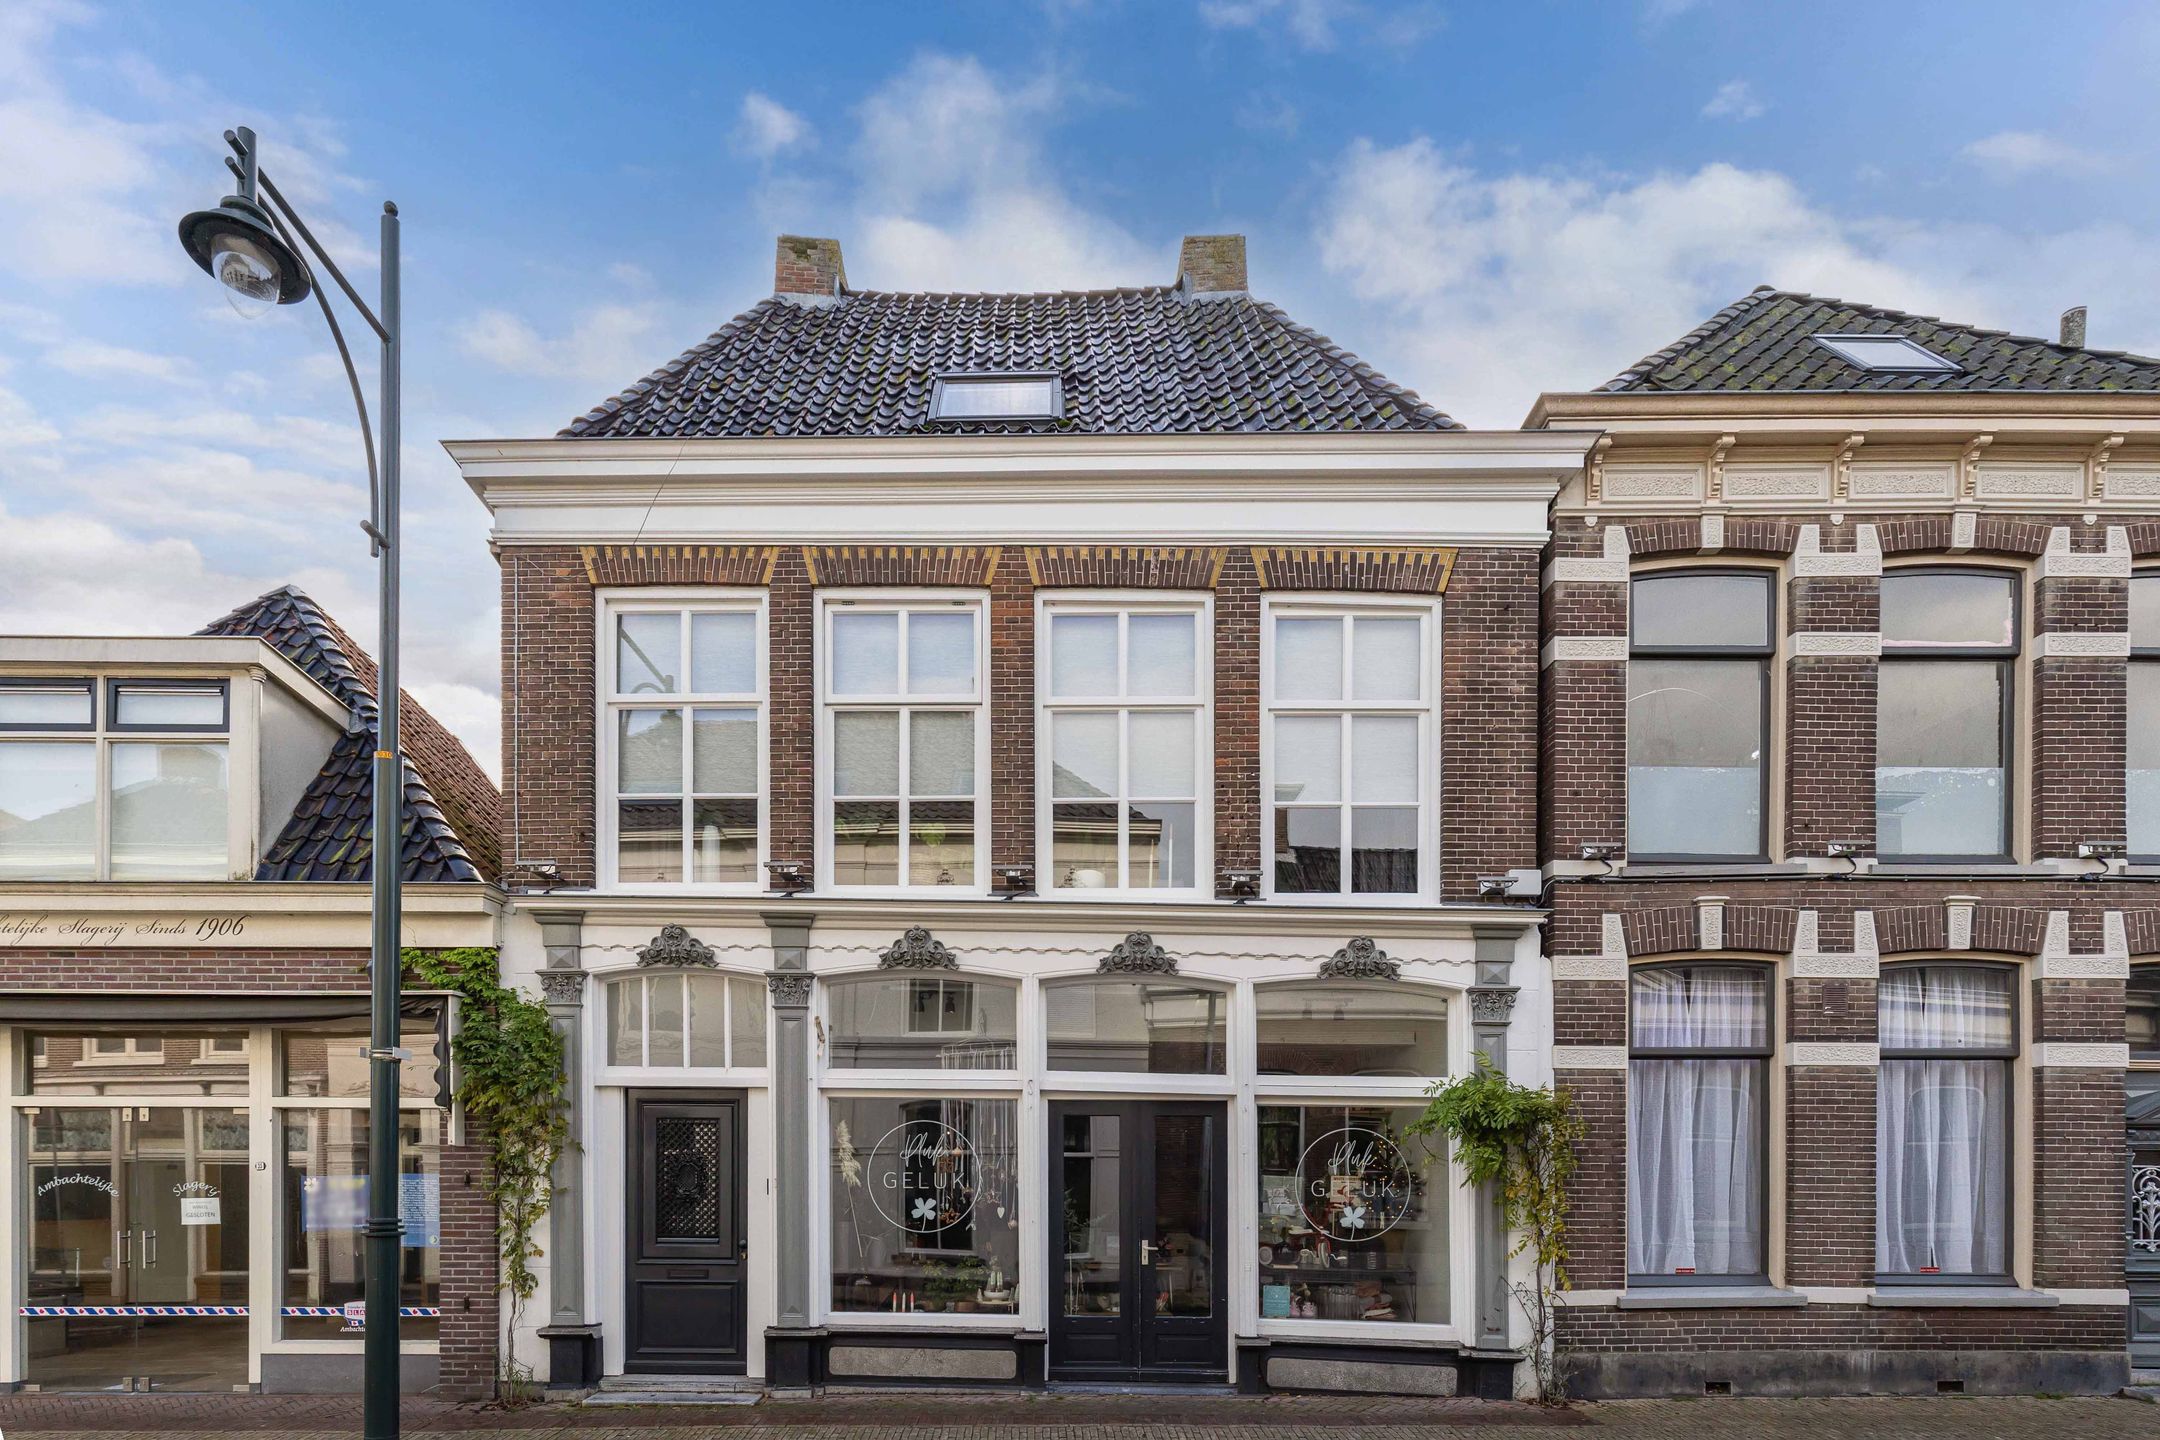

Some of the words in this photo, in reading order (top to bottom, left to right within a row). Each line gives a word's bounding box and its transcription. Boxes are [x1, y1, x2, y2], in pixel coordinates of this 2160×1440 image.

[58, 918, 127, 946] Slagerij
[135, 918, 186, 935] Sinds
[195, 914, 252, 942] 1906
[900, 1131, 949, 1168] Pluk
[1328, 1139, 1377, 1176] Pluk
[37, 1173, 119, 1197] Ambachtelijke
[172, 1181, 221, 1197] Slagerij
[883, 1172, 966, 1189] GELUK
